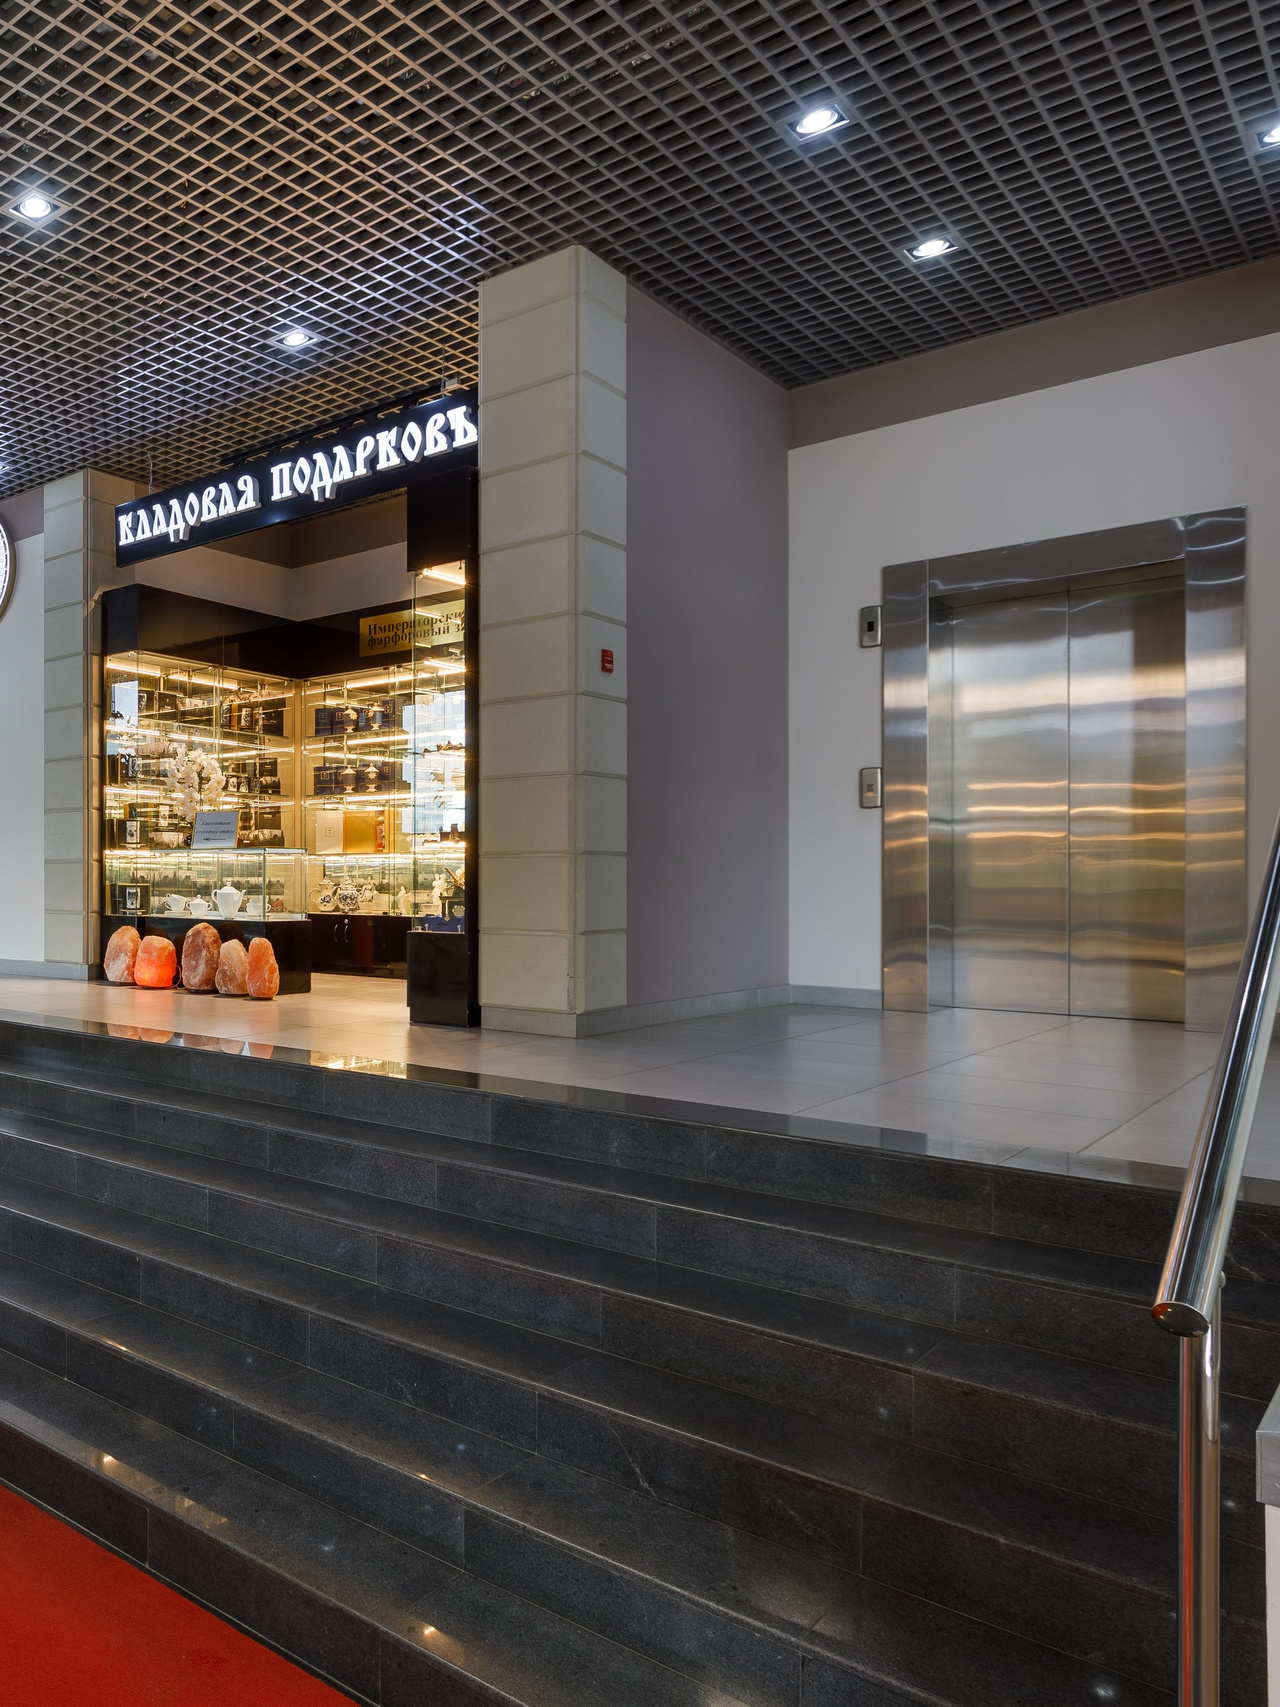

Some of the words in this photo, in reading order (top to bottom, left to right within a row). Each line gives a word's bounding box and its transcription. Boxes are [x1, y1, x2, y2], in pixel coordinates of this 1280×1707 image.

[118, 474, 258, 545] КЛАДОВАЯ
[270, 405, 478, 501] ПОДАРКОВЪ
[367, 622, 450, 650] фарфоровый
